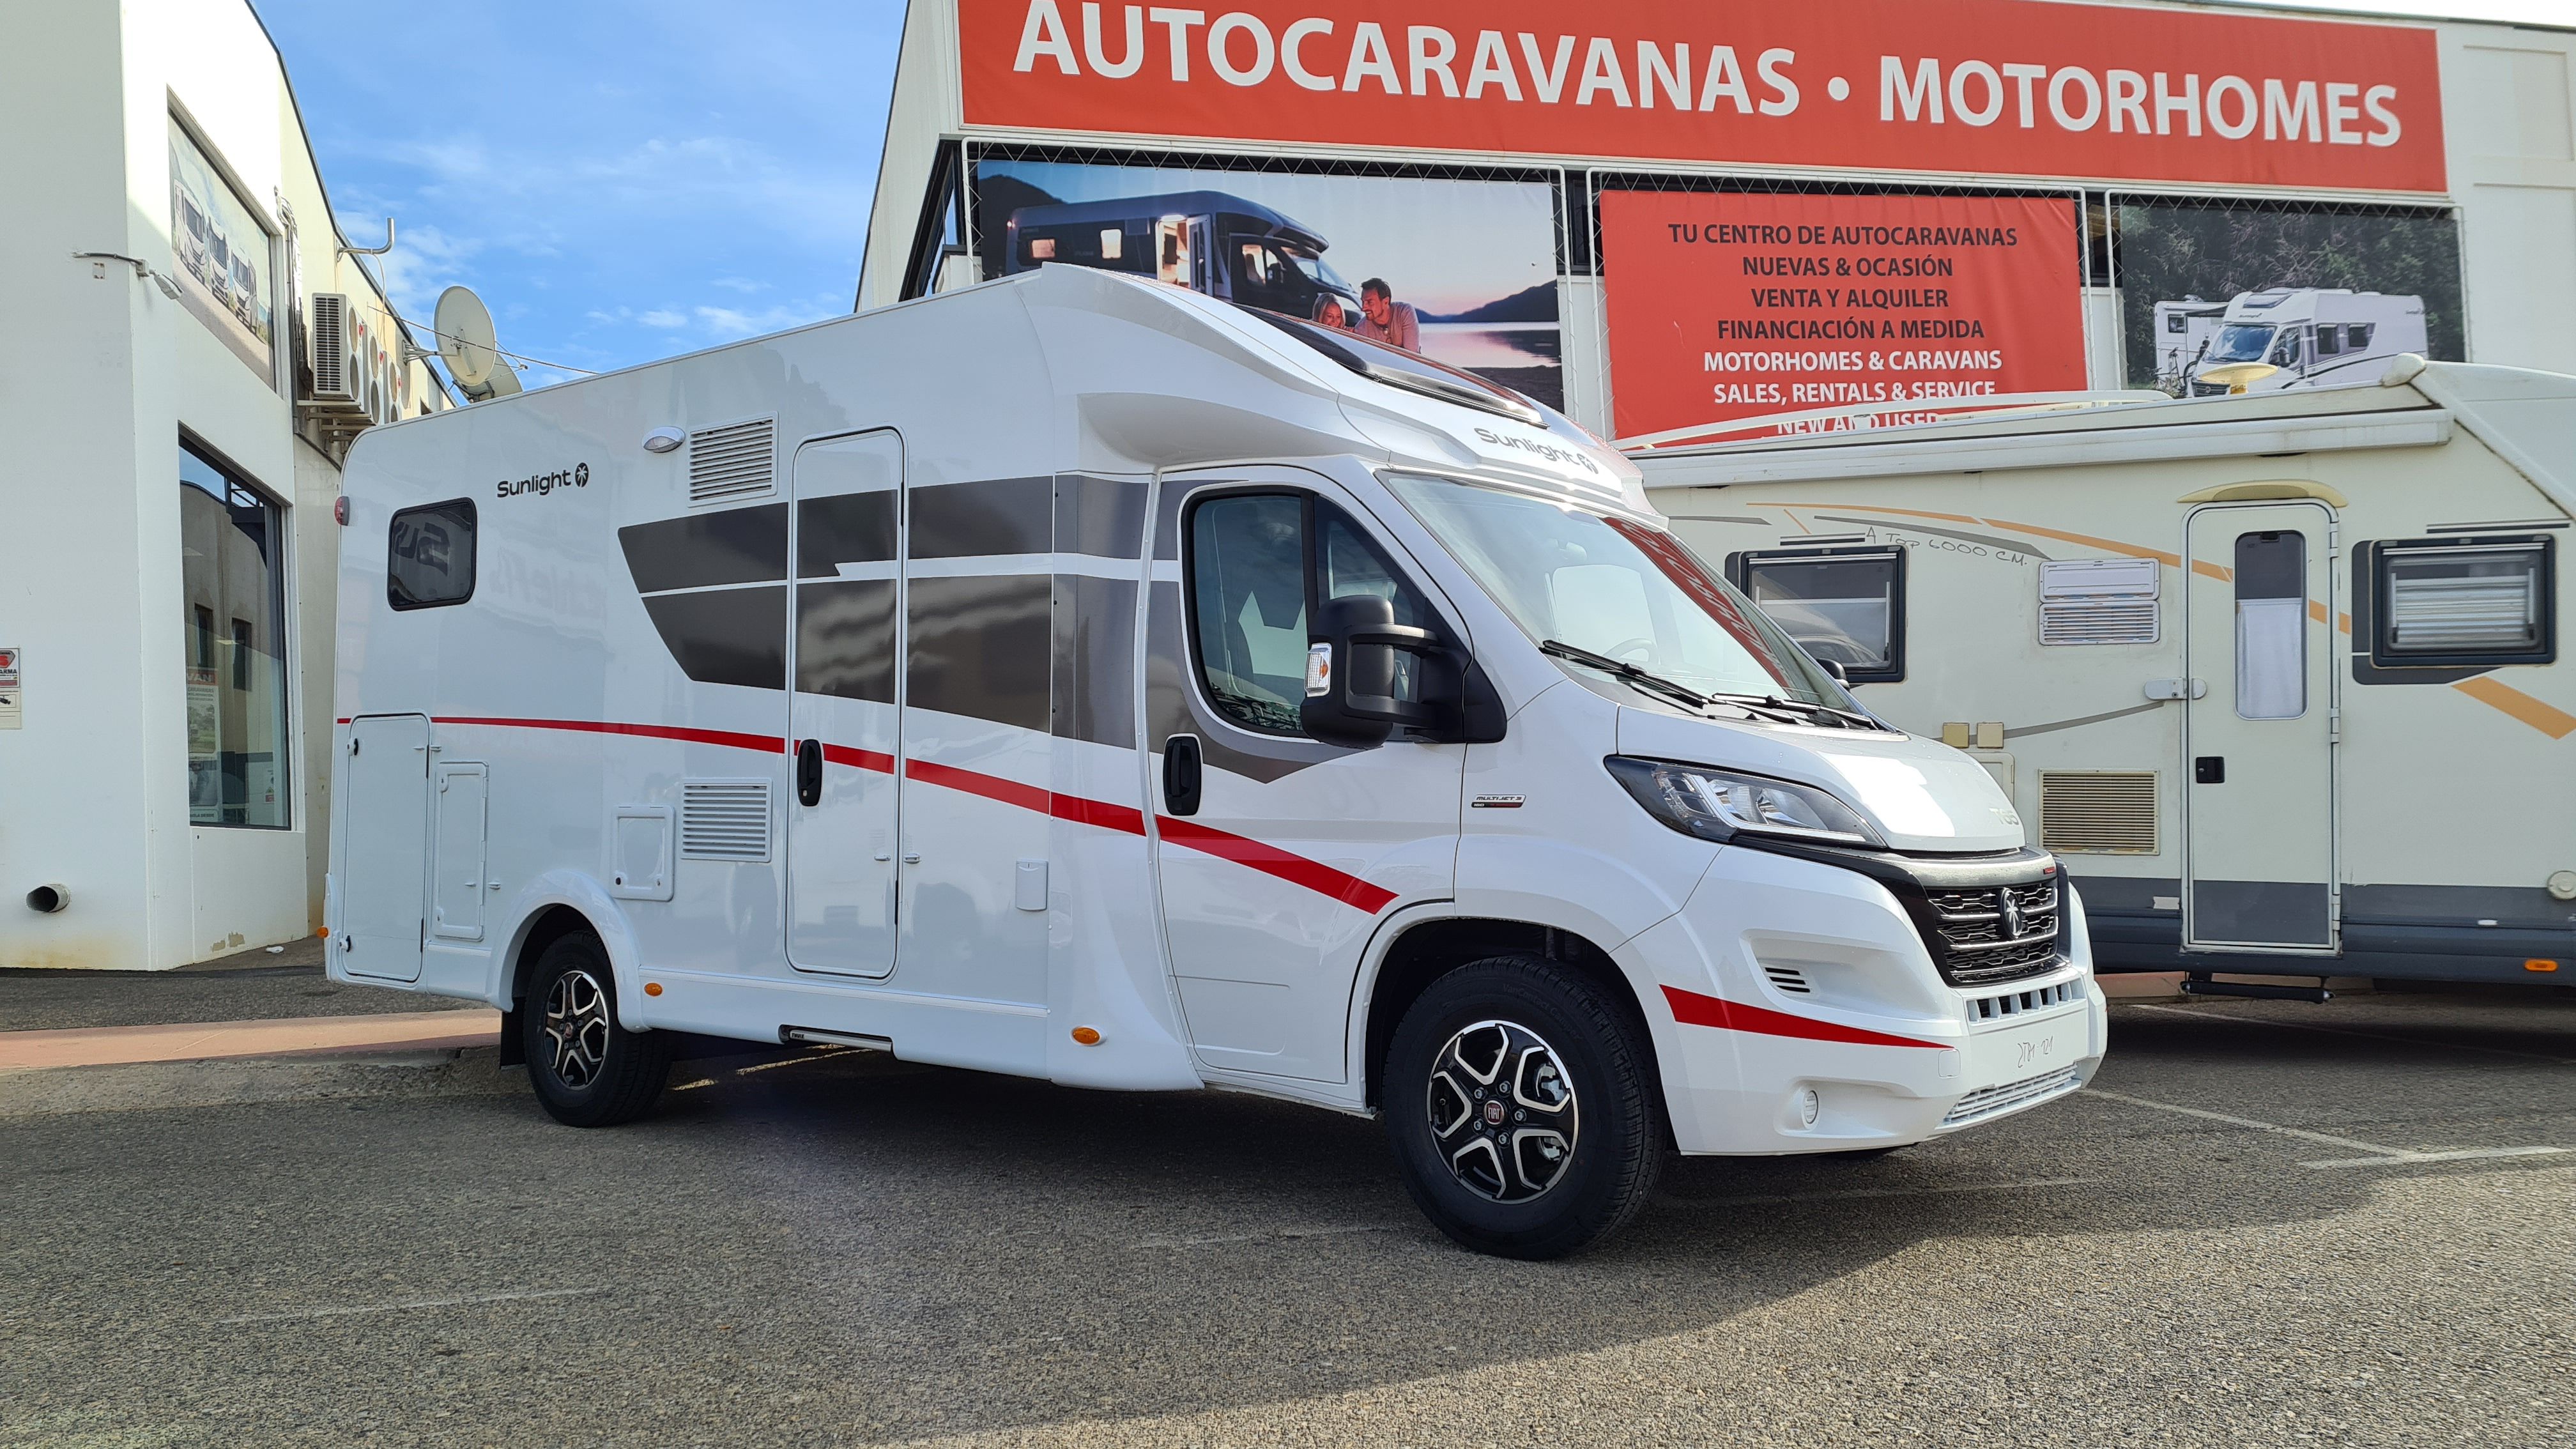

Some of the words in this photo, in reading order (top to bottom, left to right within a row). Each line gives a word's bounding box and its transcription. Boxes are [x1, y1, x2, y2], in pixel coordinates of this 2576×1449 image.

[1013, 0, 1799, 116] AUTOCARAVANAS
[1880, 56, 2401, 146] MOTORHOMES
[1668, 224, 1698, 243] TU
[1704, 224, 1791, 244] CENTRO
[1798, 226, 1826, 244] DE
[1832, 226, 2018, 246] AUTOCARAVANAS
[1743, 257, 1830, 276] NUEVAS
[1836, 257, 1851, 276] &
[1856, 254, 1953, 277] OCASIÓN
[1751, 289, 1823, 307] VENTA
[1827, 289, 1840, 307] Y
[1846, 289, 1949, 310] ALQUILER
[1718, 316, 1875, 339] FINANCIACIÓN
[1881, 320, 1896, 339] A
[1901, 319, 1984, 339] MEDIDA
[1704, 351, 1864, 371] MOTORHOMES
[1869, 351, 1885, 370] &
[1889, 350, 2002, 370] CARAVANS
[1714, 383, 1787, 406] SALES,
[1793, 382, 1887, 403] RENTALS
[1891, 383, 1906, 401] &
[1912, 381, 1996, 399] SERVICE
[1777, 418, 1827, 434] NEW
[1473, 427, 1580, 466] Sunlight
[497, 470, 571, 498] Sunlight
[1929, 539, 1988, 556] 6000
[1488, 1107, 1501, 1120] FIAT
